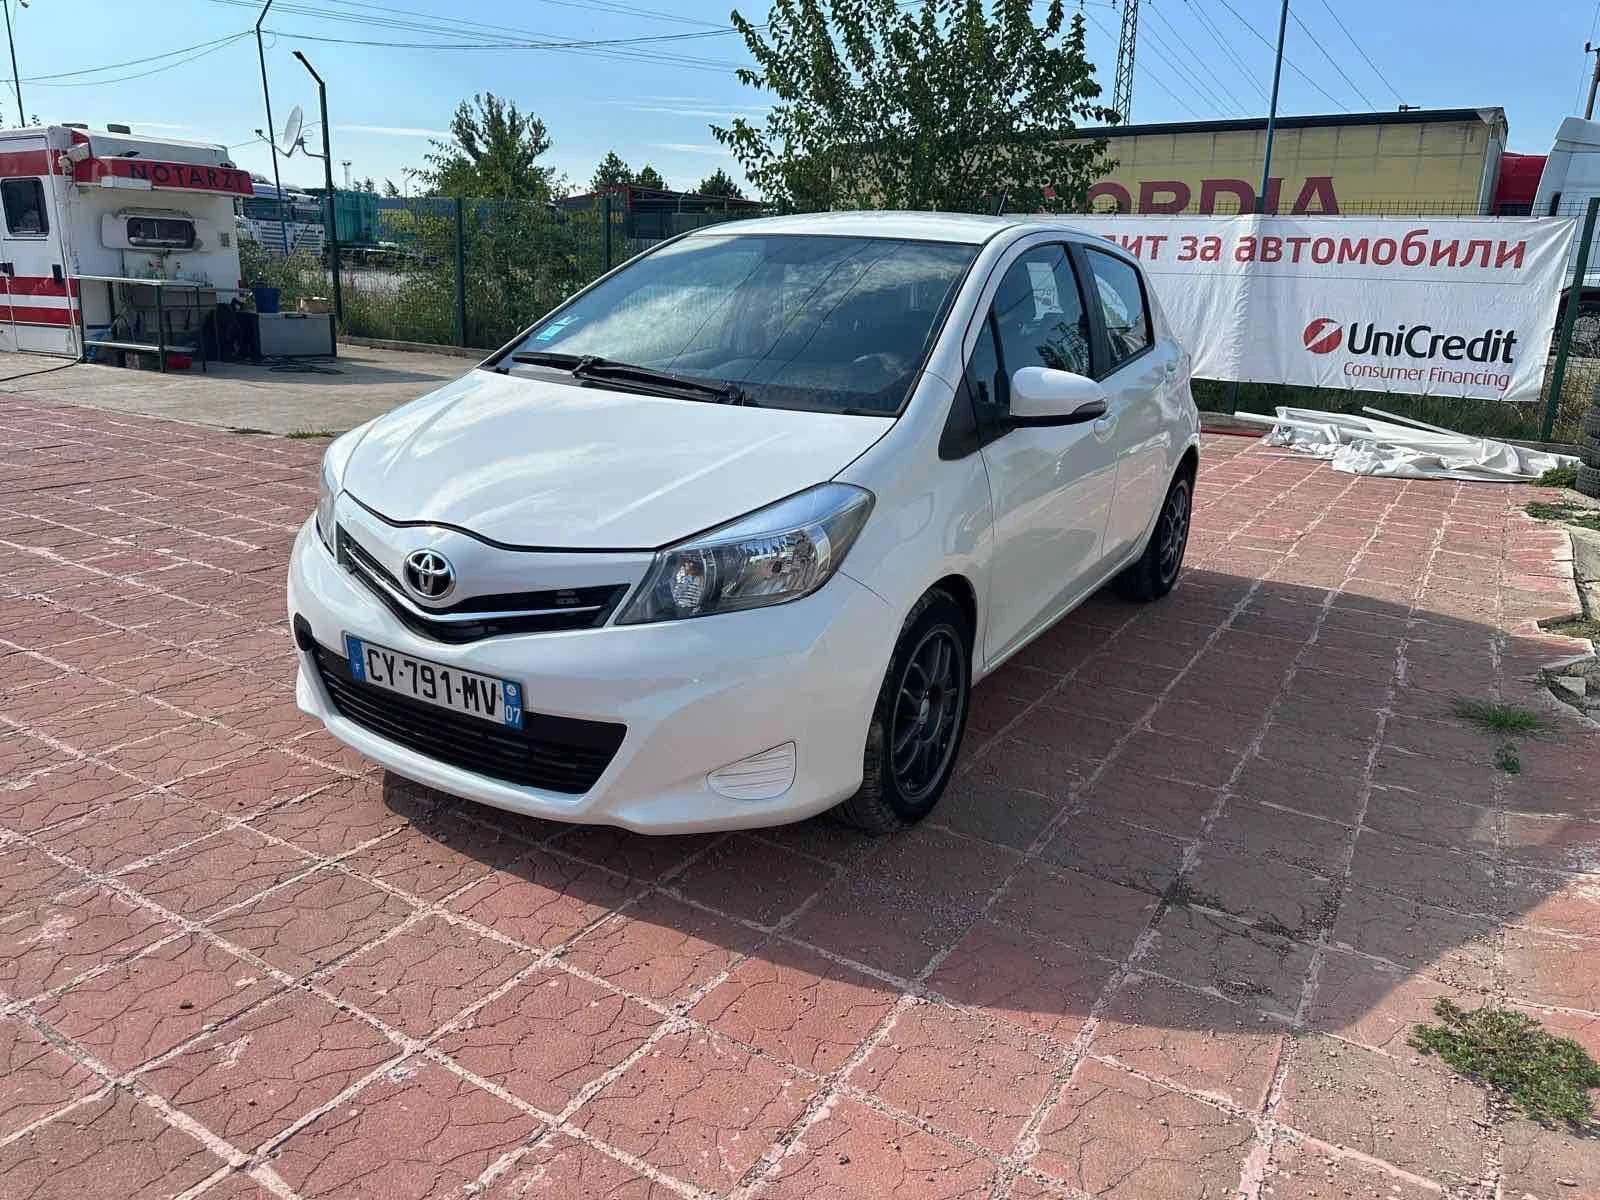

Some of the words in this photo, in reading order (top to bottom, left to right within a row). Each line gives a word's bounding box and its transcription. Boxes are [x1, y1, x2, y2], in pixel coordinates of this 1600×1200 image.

[129, 163, 248, 193] NOTARZT
[1102, 235, 1168, 260] ит
[1177, 235, 1222, 262] за
[1234, 229, 1527, 269] автомобили
[1347, 322, 1517, 364] UniCredit
[1343, 362, 1424, 382] Consumer
[1429, 367, 1511, 392] Financing
[367, 648, 497, 716] CY-791-MV
[505, 704, 521, 724] 07
